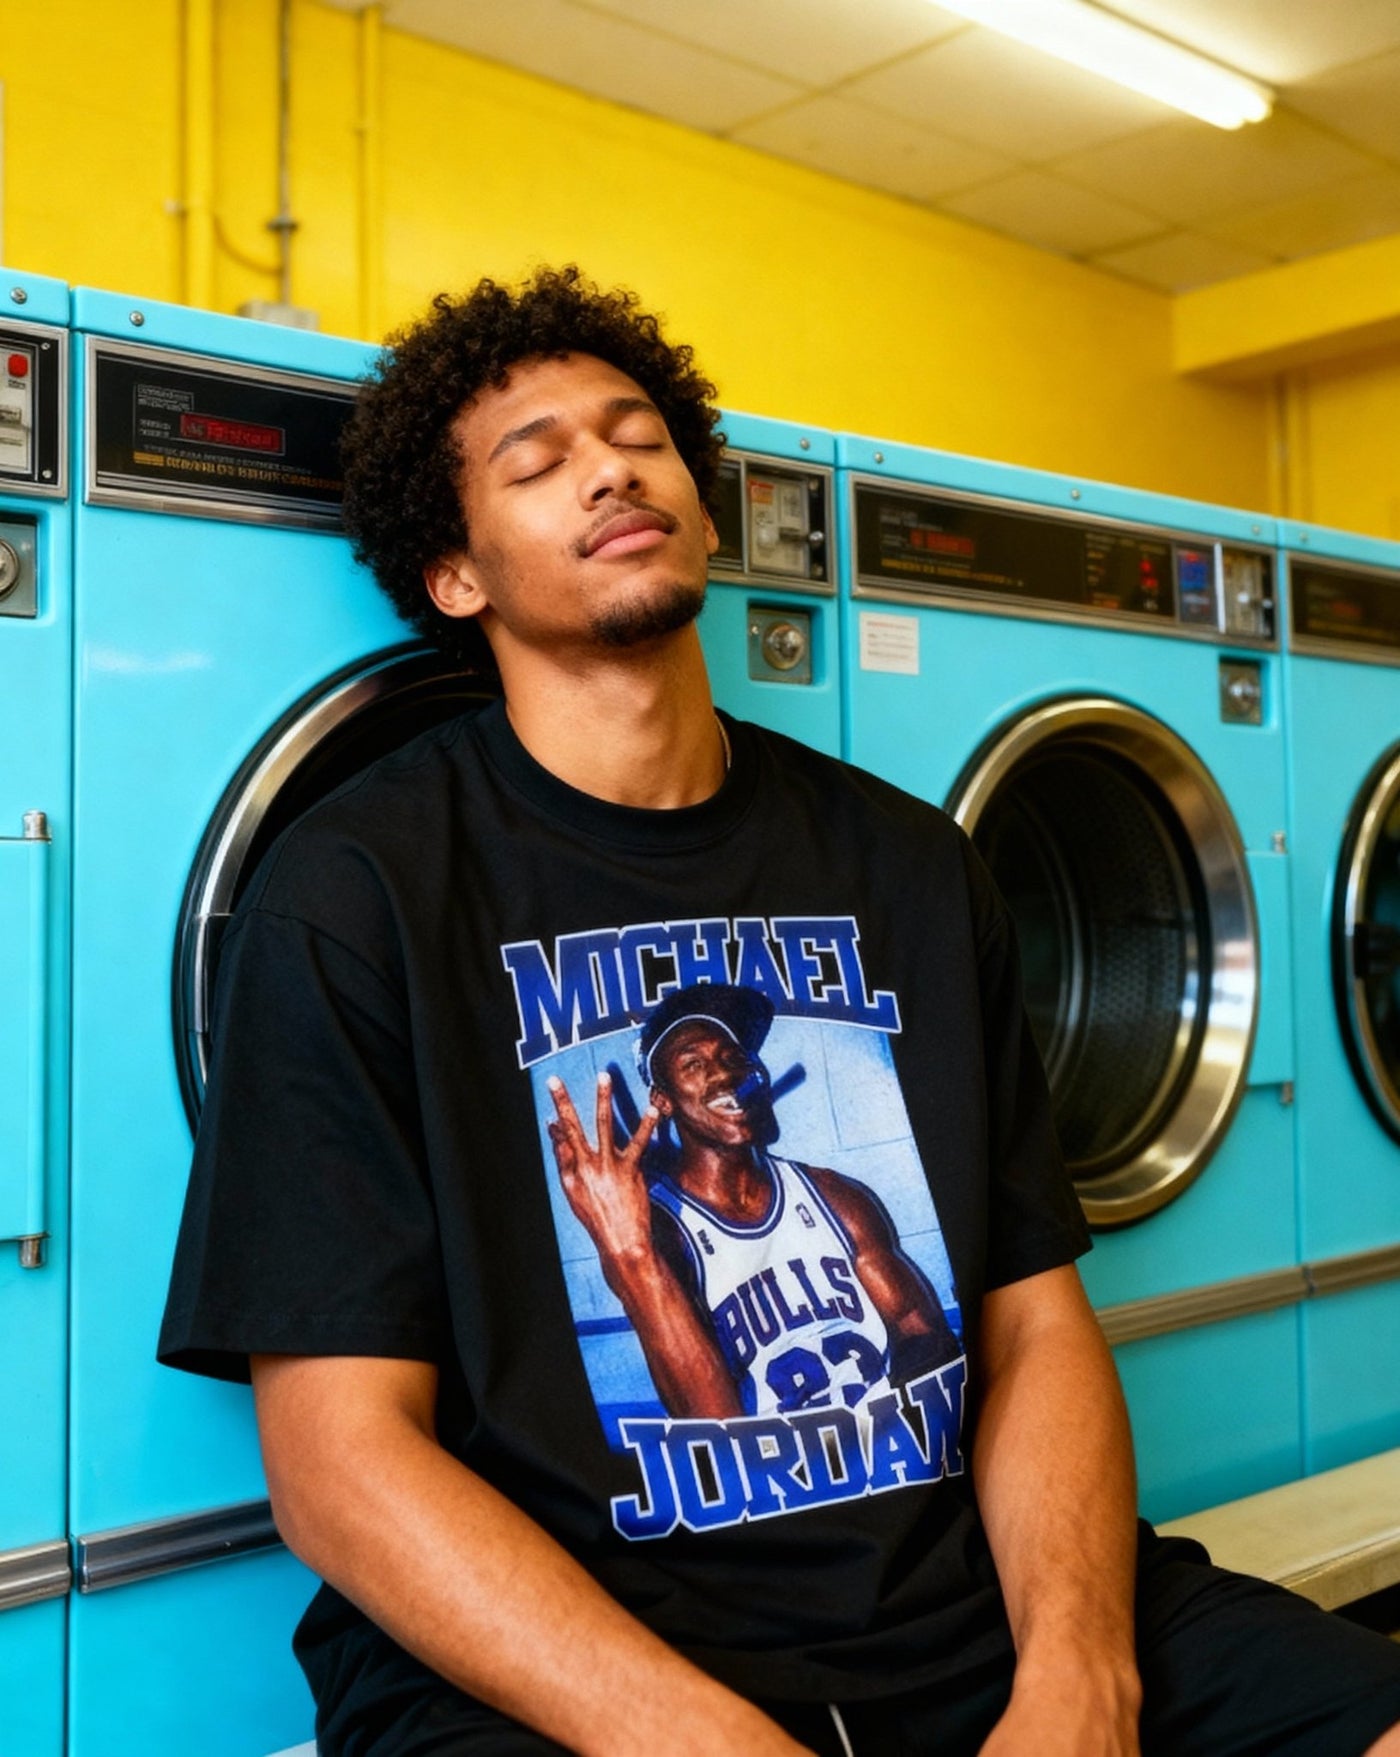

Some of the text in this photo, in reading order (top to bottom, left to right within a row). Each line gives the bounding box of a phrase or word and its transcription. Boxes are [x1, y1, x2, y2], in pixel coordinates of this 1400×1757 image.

[501, 916, 901, 1069] MICHAEL
[711, 1256, 865, 1377] BULLS
[610, 1353, 967, 1541] JORDAN
